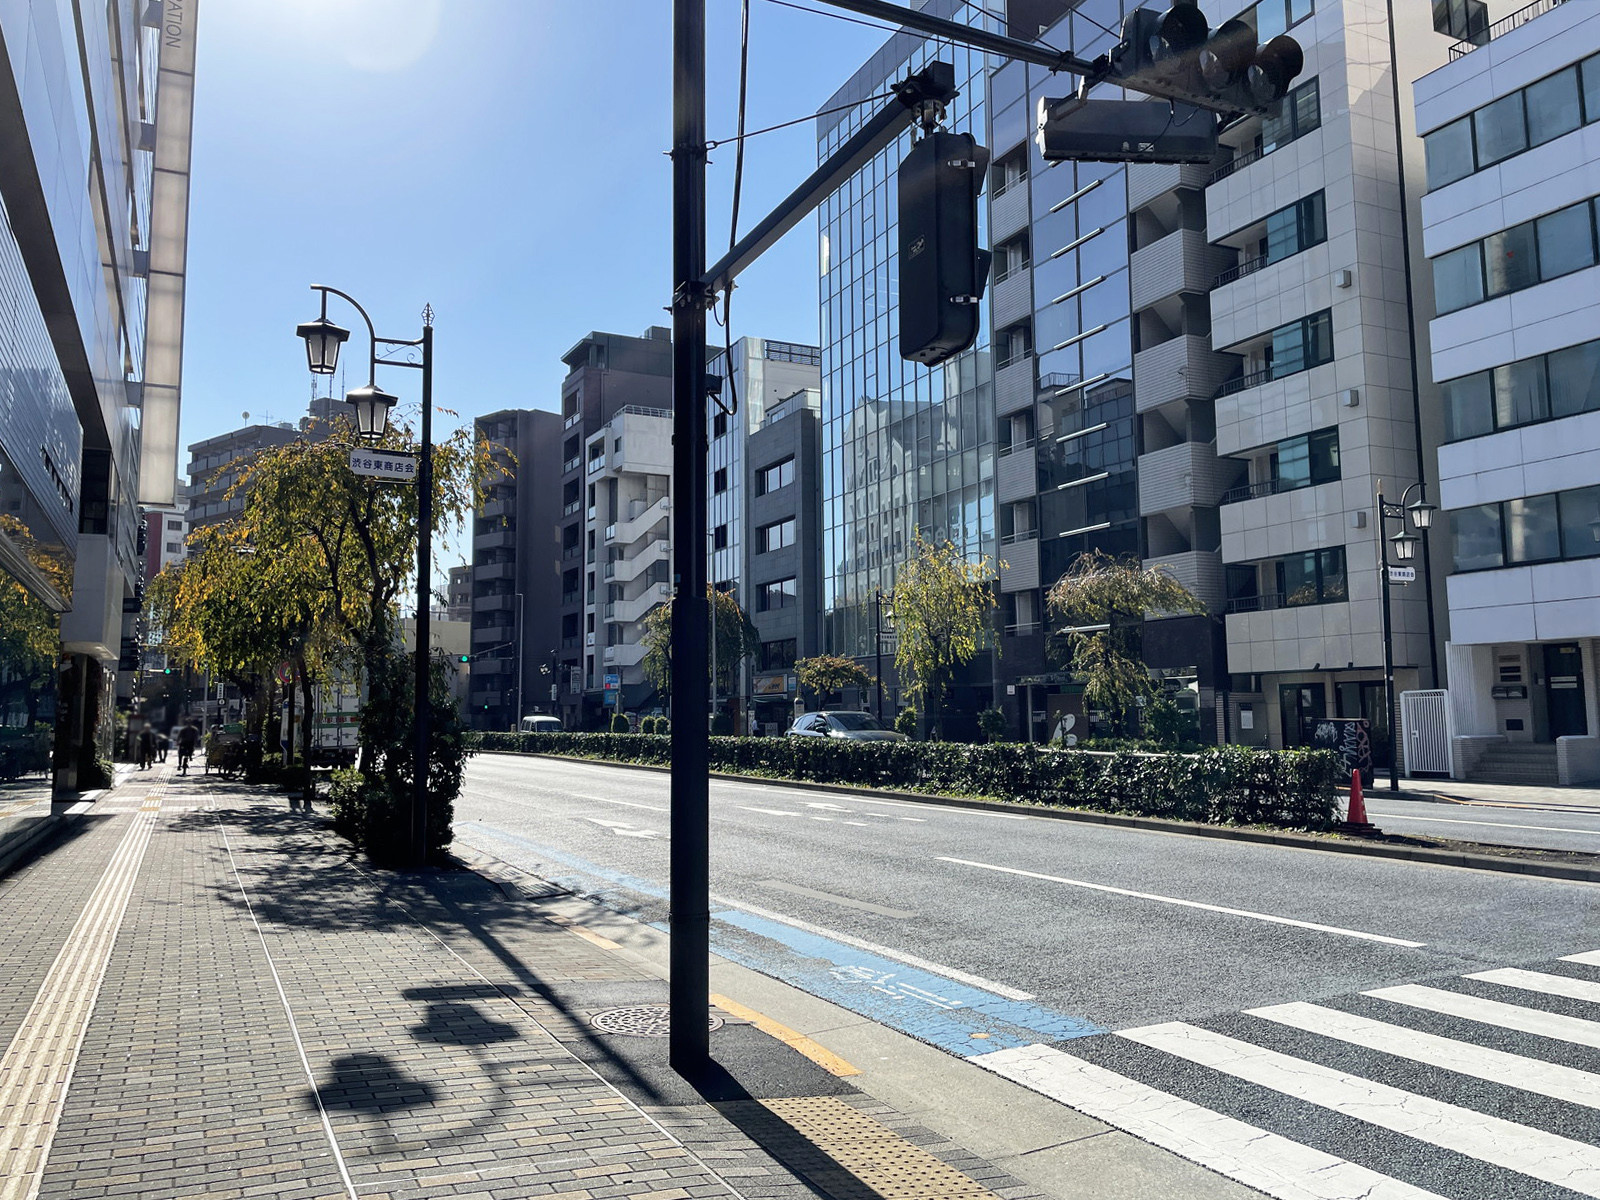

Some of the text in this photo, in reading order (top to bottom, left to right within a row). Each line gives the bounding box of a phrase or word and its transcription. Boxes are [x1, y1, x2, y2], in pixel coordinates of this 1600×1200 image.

[166, 0, 182, 48] ATION
[352, 457, 414, 473] 渋谷東商店会
